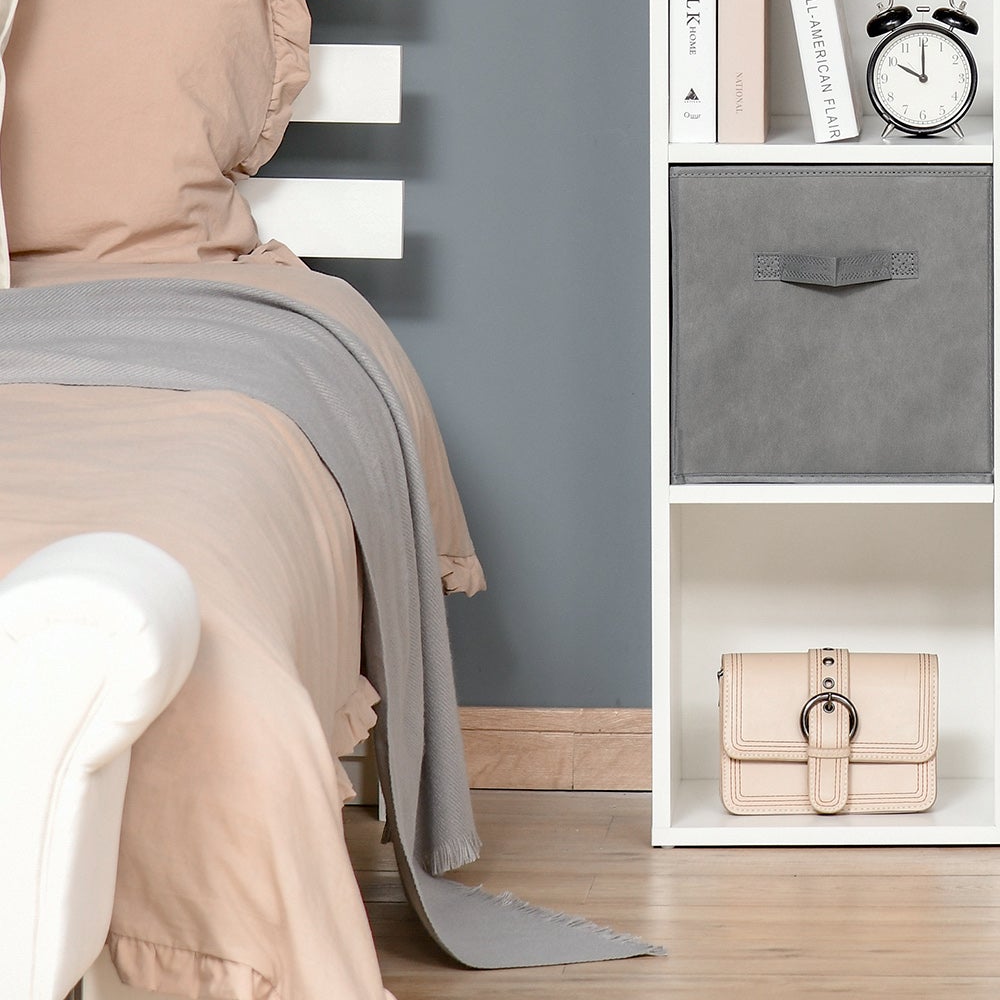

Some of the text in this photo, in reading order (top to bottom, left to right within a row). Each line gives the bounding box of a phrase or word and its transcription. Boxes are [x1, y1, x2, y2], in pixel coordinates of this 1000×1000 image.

[689, 26, 697, 56] HOME
[918, 37, 928, 47] 12
[901, 43, 909, 53] 11
[939, 42, 943, 52] 1
[888, 57, 898, 67] 10
[952, 54, 959, 65] 2
[881, 74, 888, 84] 9
[958, 73, 965, 84] 3
[736, 71, 744, 114] NATIONAL
[887, 92, 894, 102] 8
[952, 91, 958, 101] 4
[902, 105, 909, 115] 7
[919, 110, 927, 120] 6
[939, 105, 946, 115] 5
[823, 97, 841, 140] FLAIR
